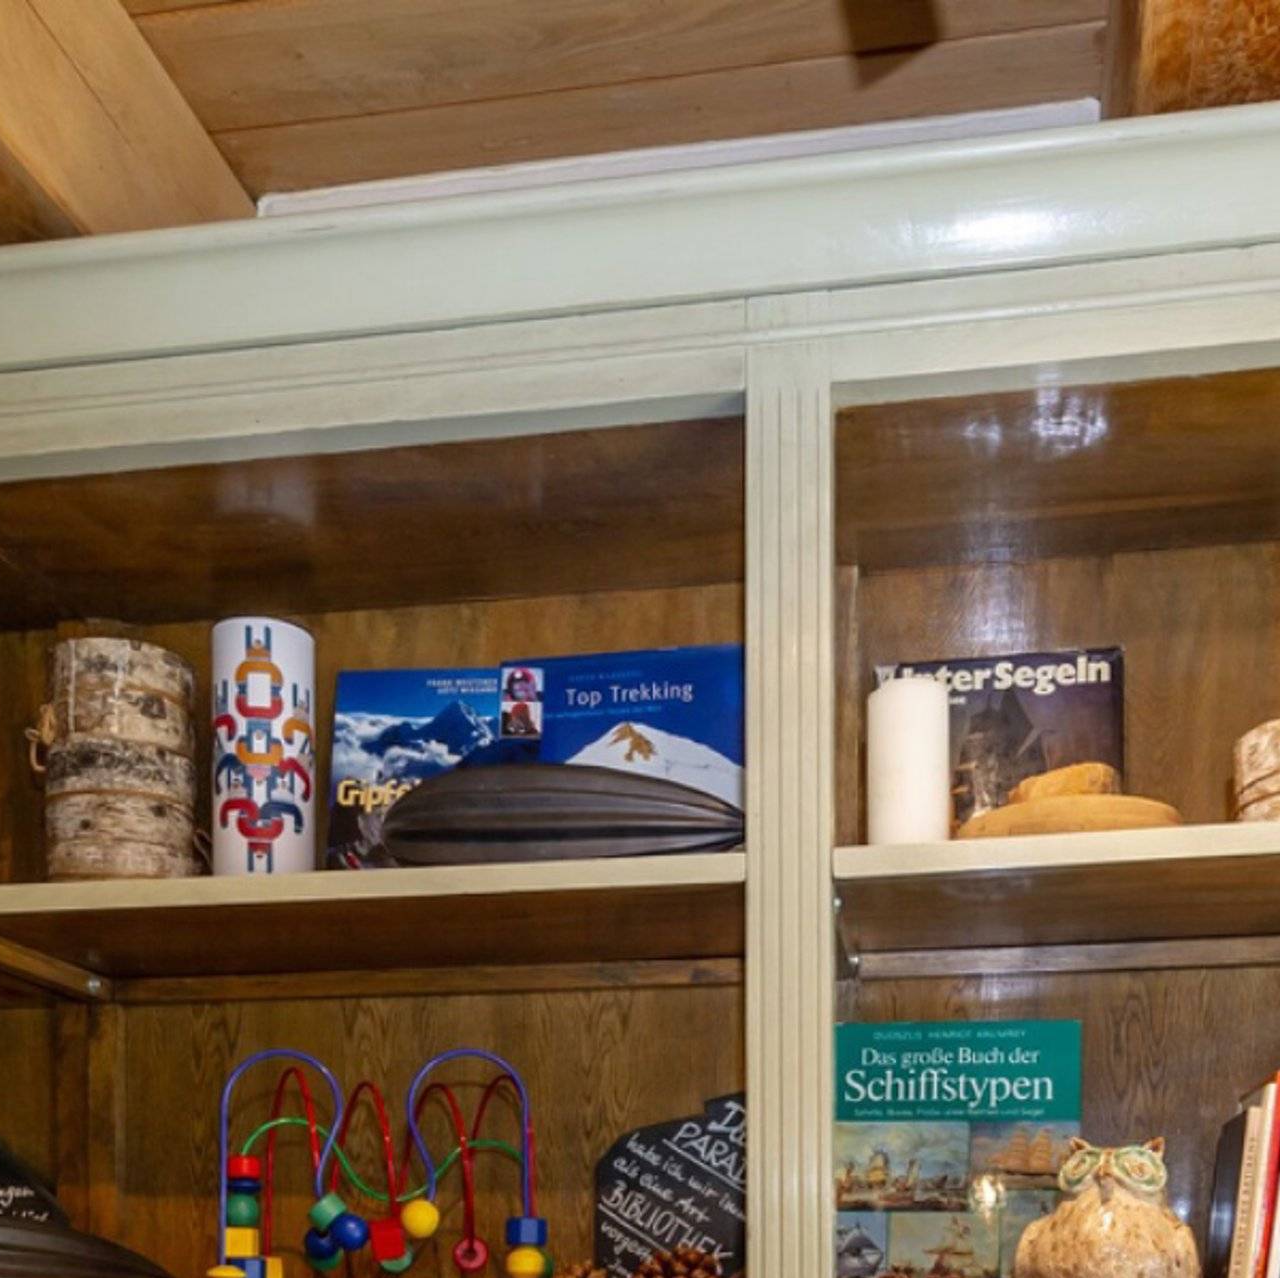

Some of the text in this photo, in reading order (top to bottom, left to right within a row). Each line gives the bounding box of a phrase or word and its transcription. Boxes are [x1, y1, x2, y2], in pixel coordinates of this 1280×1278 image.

[565, 681, 694, 709] Top Trekking
[993, 655, 1112, 696] Segeln
[861, 1047, 1040, 1070] Das große Buch der
[844, 1068, 1055, 1109] Schiffstypen
[601, 1180, 734, 1276] BIBLIOTHEK
